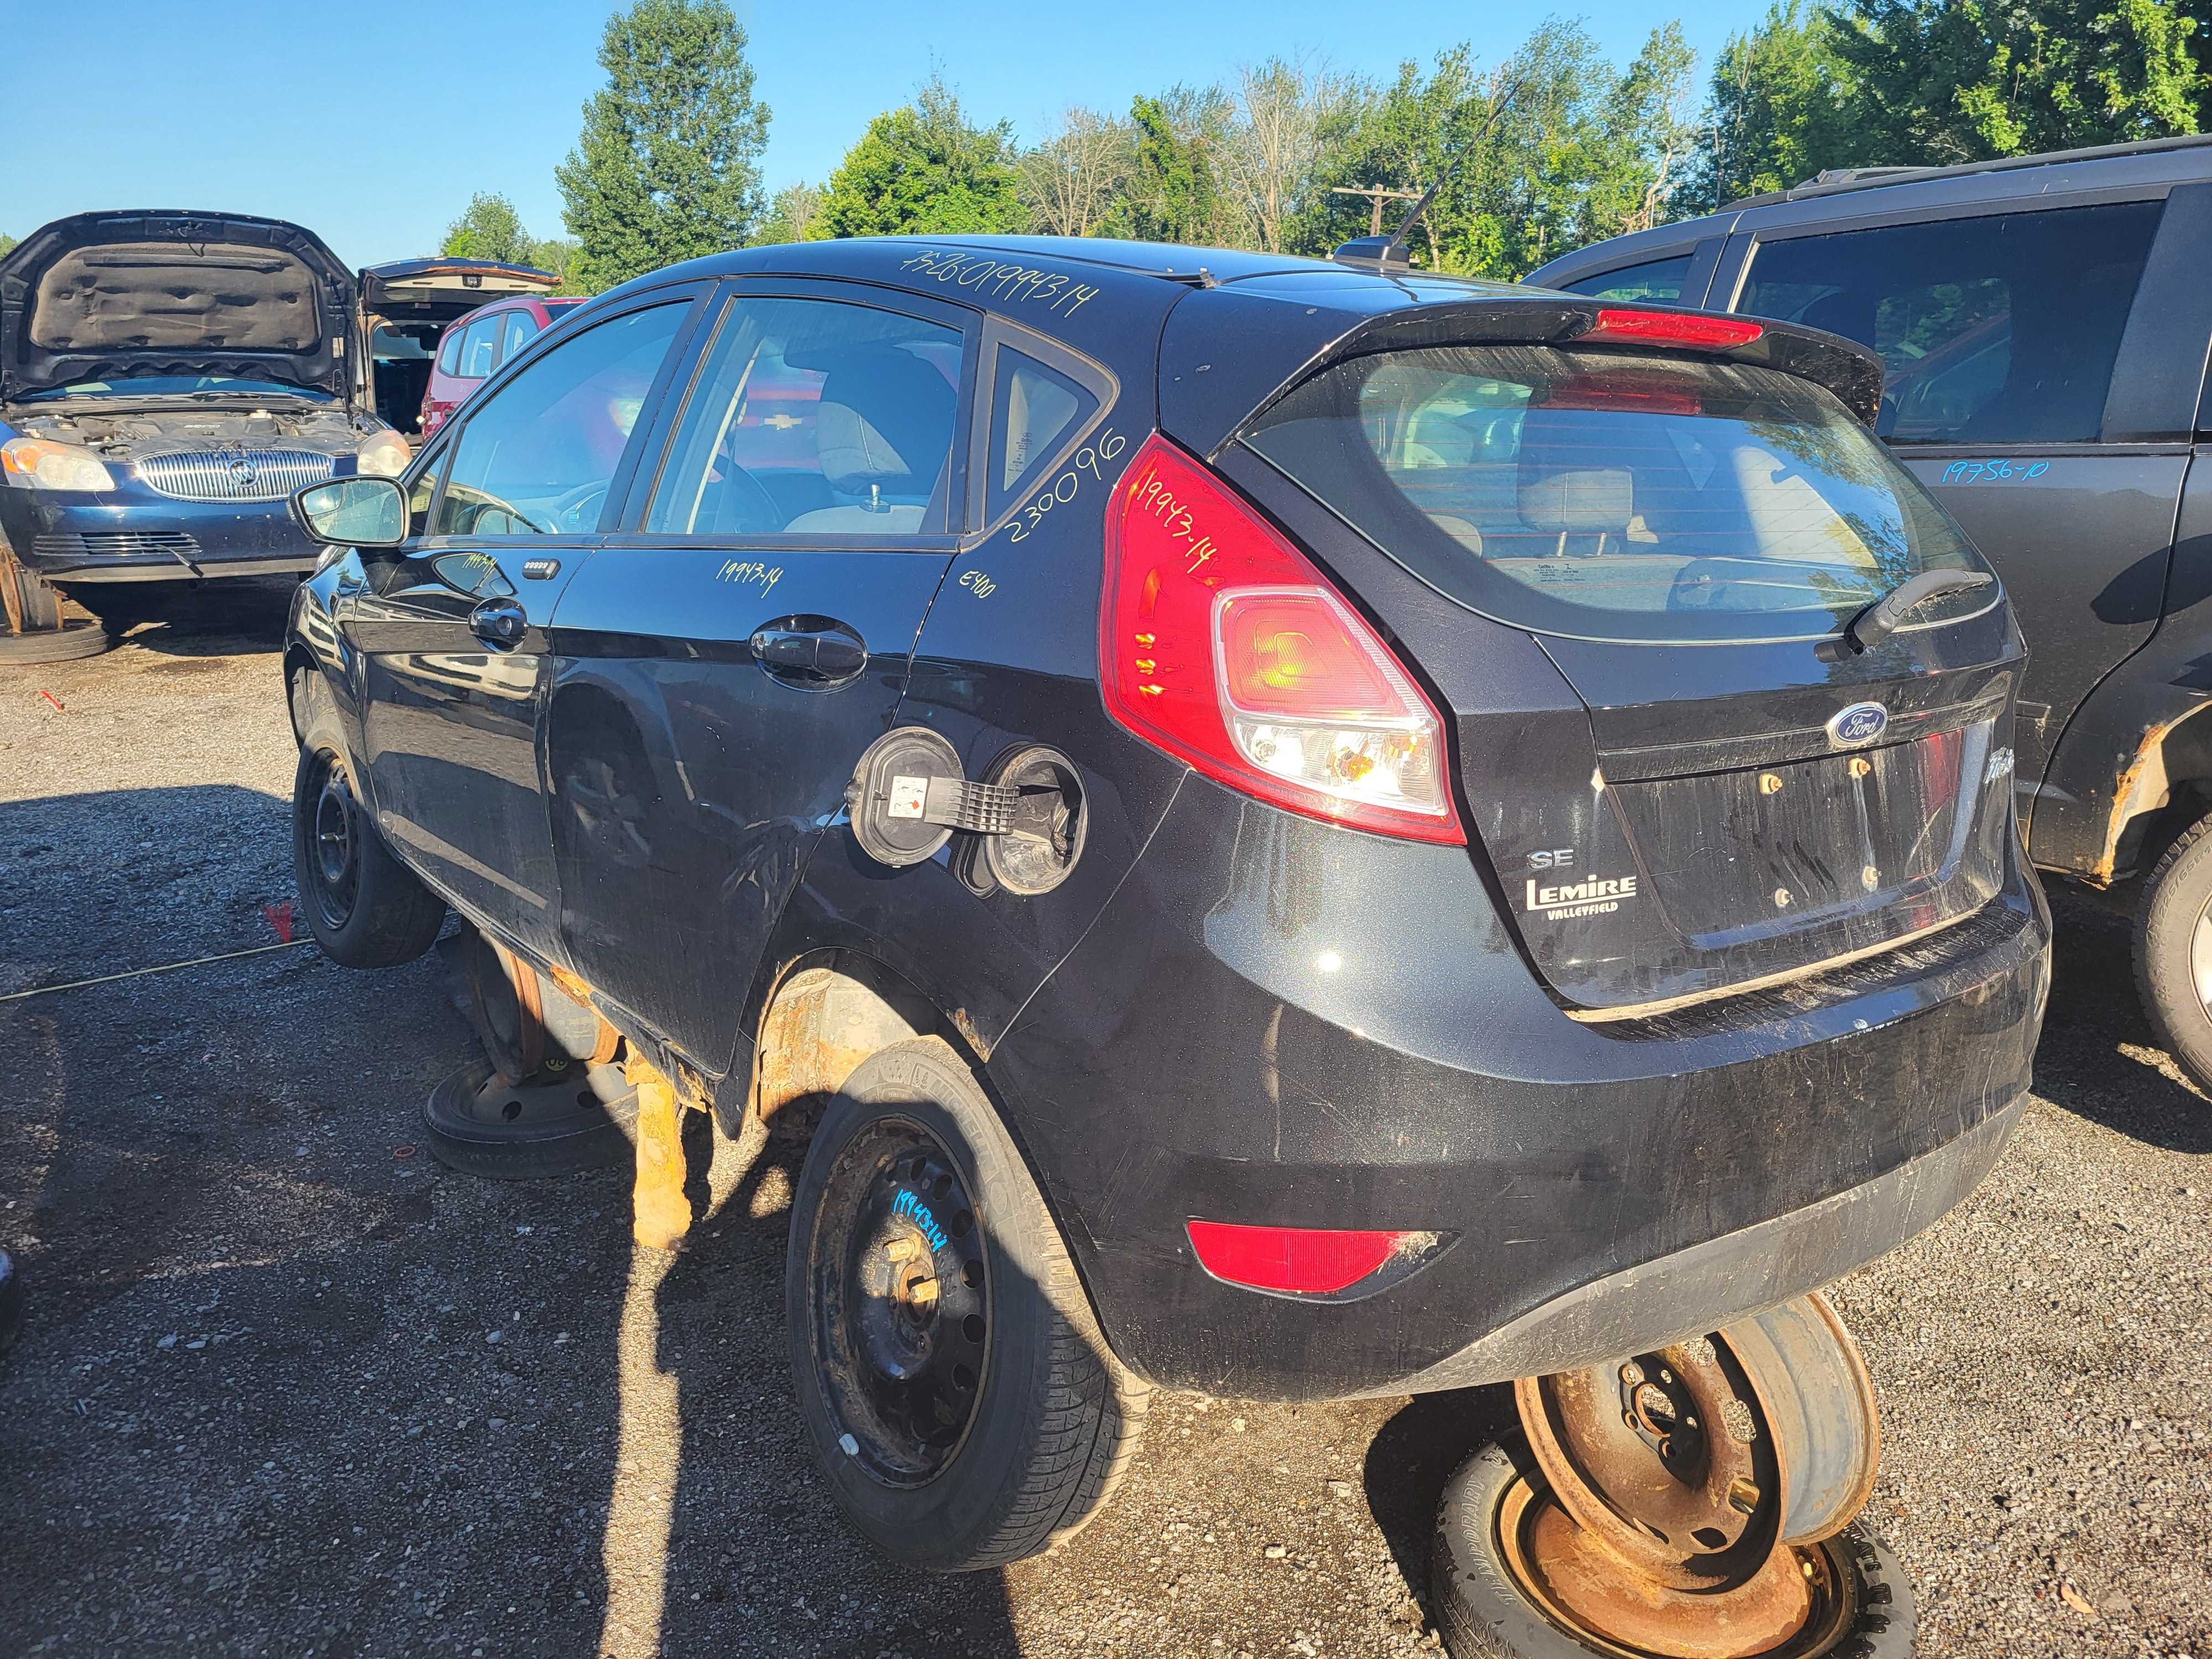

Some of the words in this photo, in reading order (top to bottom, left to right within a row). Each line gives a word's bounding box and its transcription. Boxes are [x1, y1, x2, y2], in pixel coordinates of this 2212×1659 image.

[1942, 460, 2049, 483] 19756-10
[1005, 427, 1126, 543] 230096
[1845, 712, 1880, 737] Ford
[1526, 849, 1574, 870] SE
[1547, 901, 1619, 921] VALLEYFIELD
